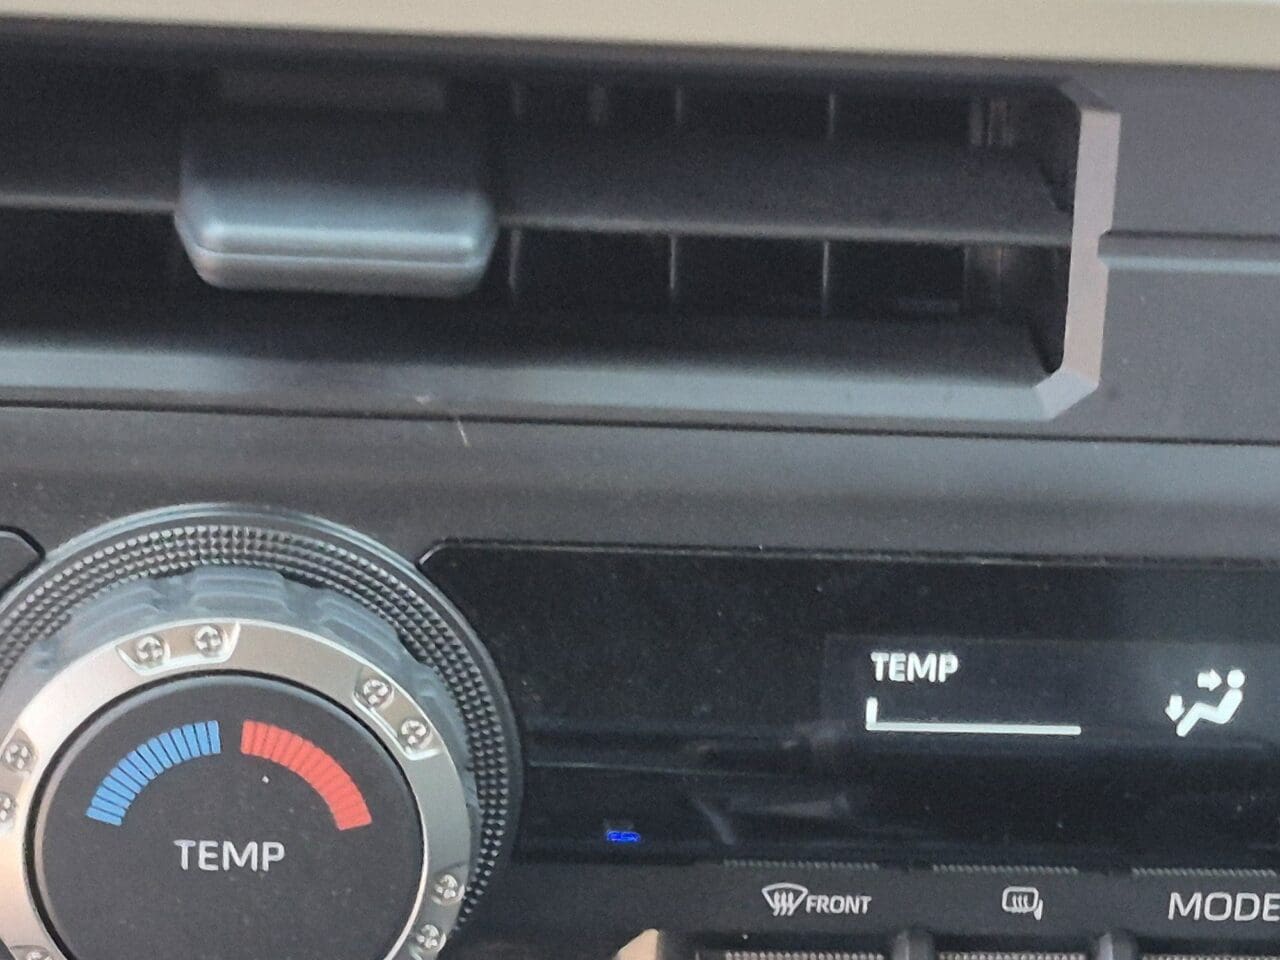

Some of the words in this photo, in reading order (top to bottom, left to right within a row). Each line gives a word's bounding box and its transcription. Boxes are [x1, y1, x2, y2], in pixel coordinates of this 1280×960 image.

[871, 651, 959, 683] TEMP
[173, 838, 286, 872] TEMP
[805, 894, 873, 915] FRONT
